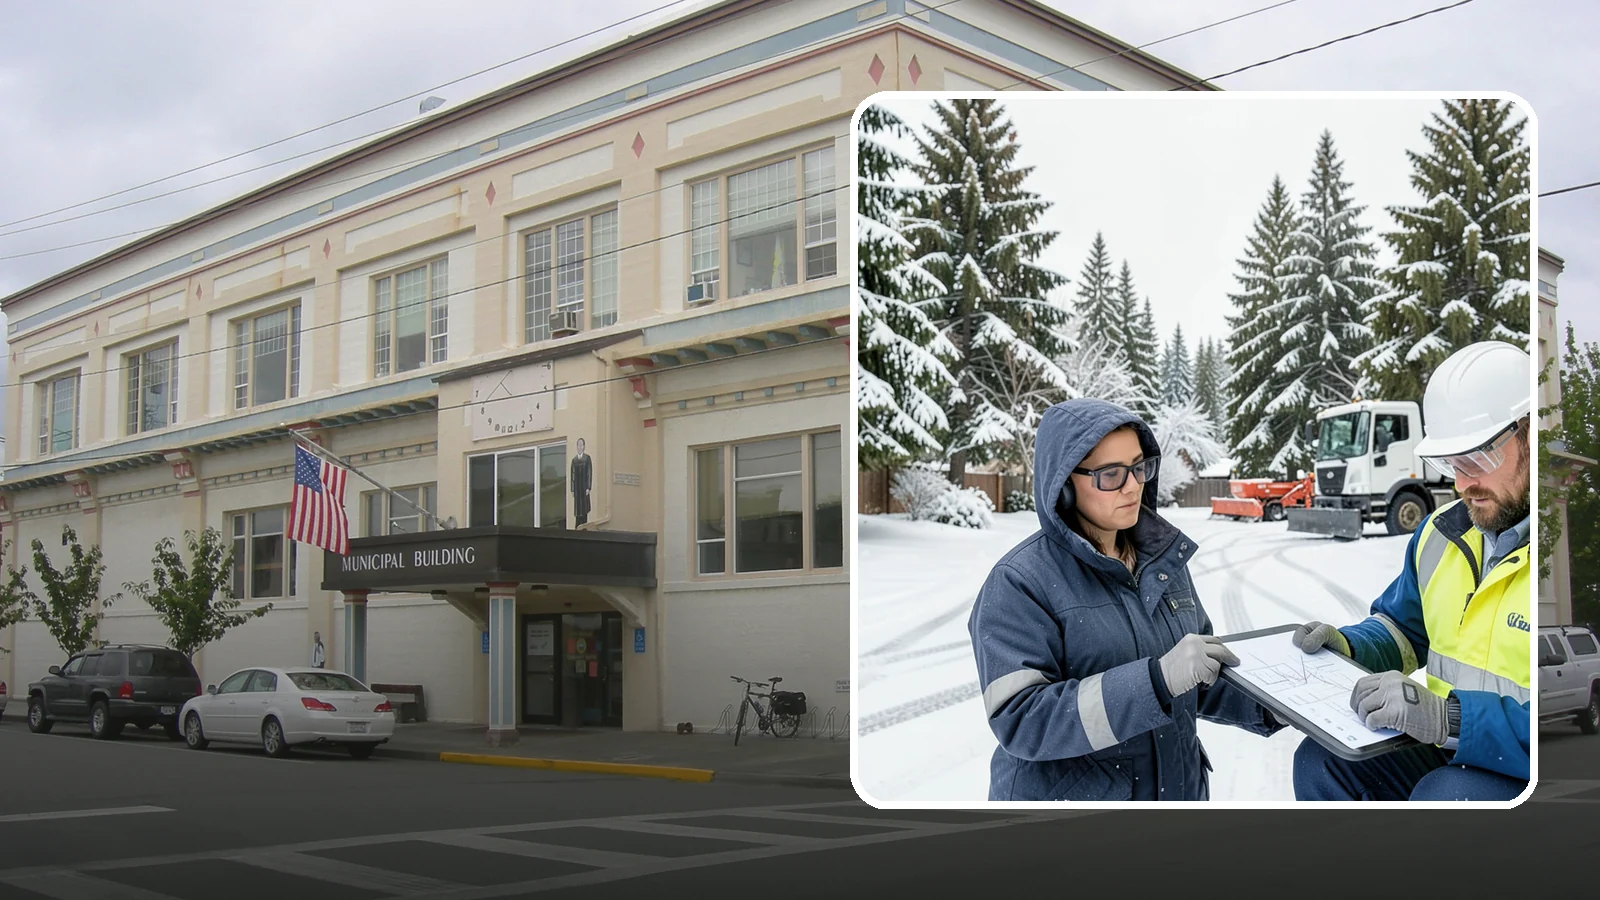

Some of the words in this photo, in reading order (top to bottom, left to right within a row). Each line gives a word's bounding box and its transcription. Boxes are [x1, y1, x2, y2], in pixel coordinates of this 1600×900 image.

[480, 407, 485, 415] 8
[487, 417, 492, 425] 9
[507, 425, 513, 433] 12
[521, 420, 526, 428] 2
[342, 552, 405, 572] MUNICIPAL
[414, 546, 475, 567] BUILDING
